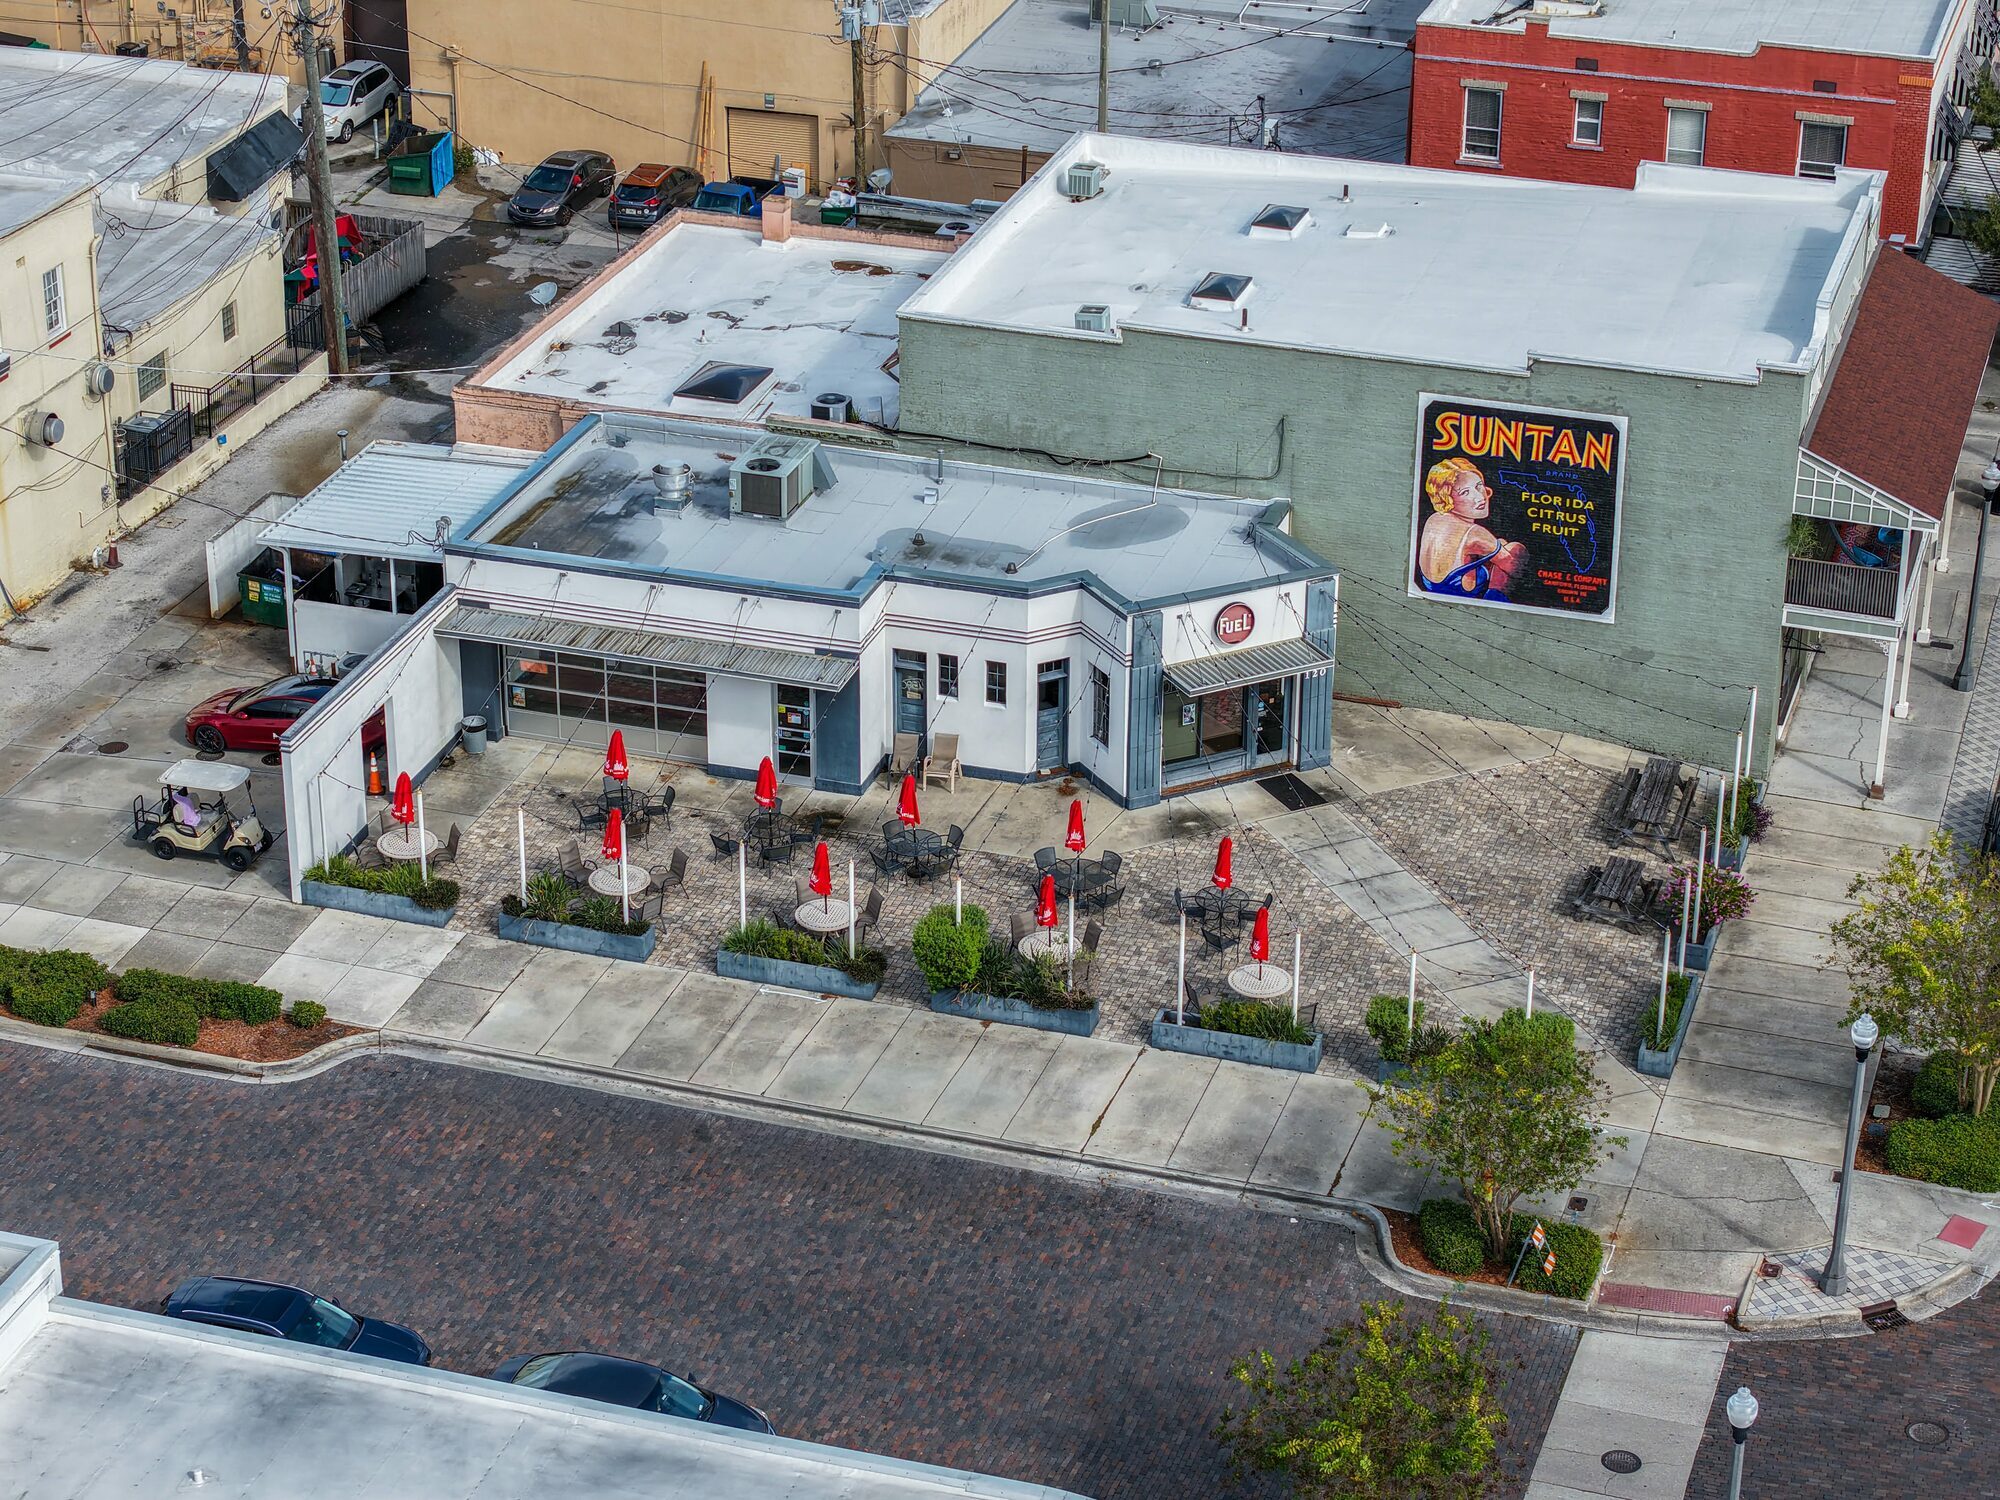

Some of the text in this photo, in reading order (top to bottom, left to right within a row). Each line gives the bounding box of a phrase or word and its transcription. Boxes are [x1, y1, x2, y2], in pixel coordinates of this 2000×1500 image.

[1432, 411, 1614, 475] SUNTAN
[1546, 470, 1579, 480] BRAND
[1521, 491, 1595, 511] FLORIDA
[1527, 507, 1587, 525] CITRUS
[1532, 522, 1580, 537] FRUIT
[1538, 570, 1563, 580] CHASE
[1573, 575, 1608, 585] COMPANY
[1304, 668, 1327, 680] 120
